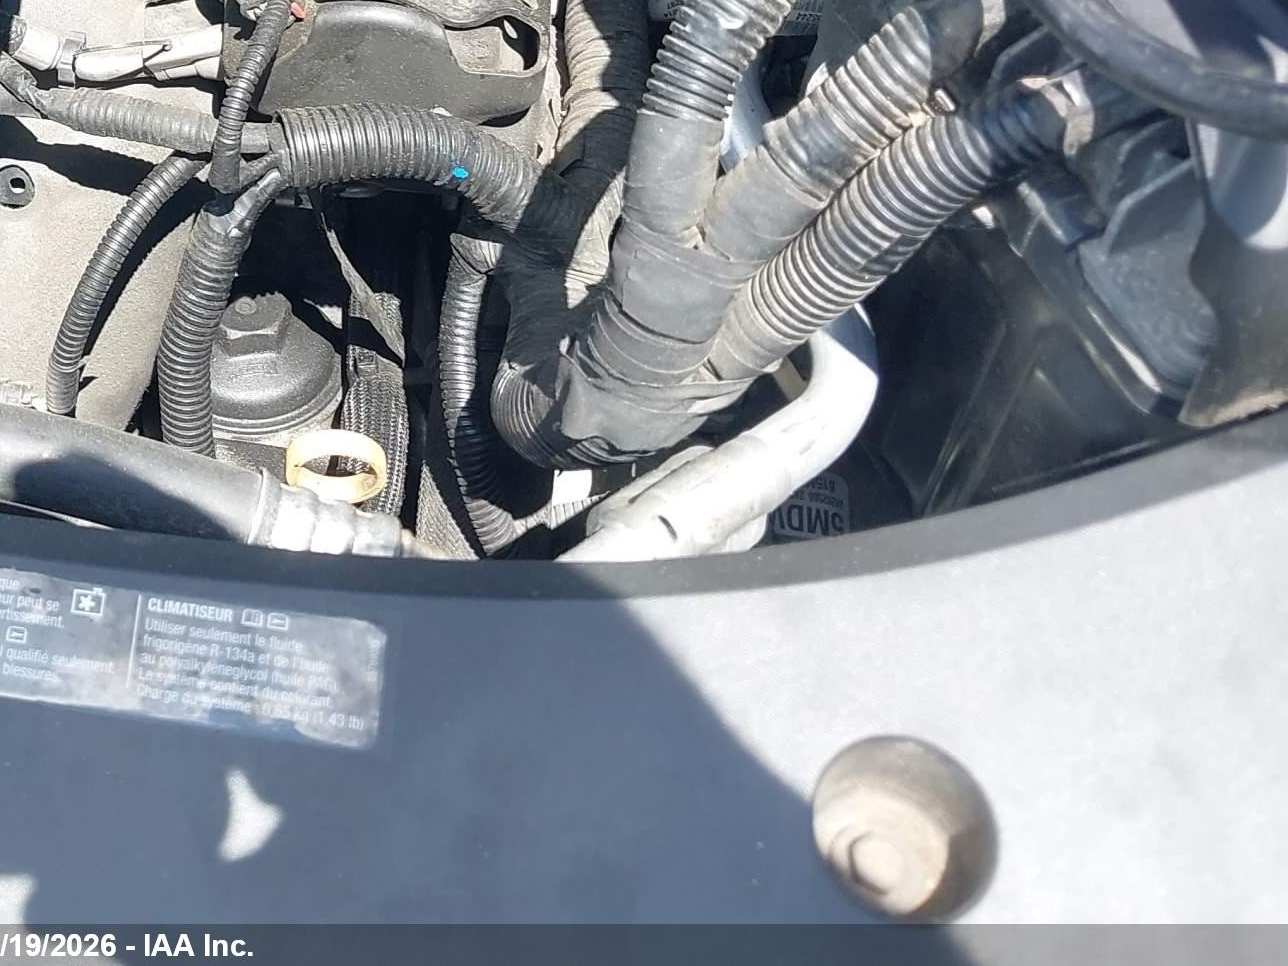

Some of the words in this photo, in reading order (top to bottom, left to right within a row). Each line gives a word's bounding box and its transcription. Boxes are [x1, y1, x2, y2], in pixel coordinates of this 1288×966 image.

[16, 593, 45, 611] peut
[45, 598, 61, 611] se
[147, 597, 233, 622] CLIMATISEUR
[144, 617, 187, 635] Utiliser
[189, 626, 252, 645] seulement
[254, 634, 267, 647] le
[269, 635, 305, 652] fluide
[6, 647, 48, 665] qualifié
[140, 652, 157, 665] au
[210, 643, 256, 663] R-134a
[257, 652, 271, 665] et
[273, 655, 290, 668] de
[136, 683, 179, 705] Charge
[138, 667, 155, 682] Le
[261, 685, 280, 700] du
